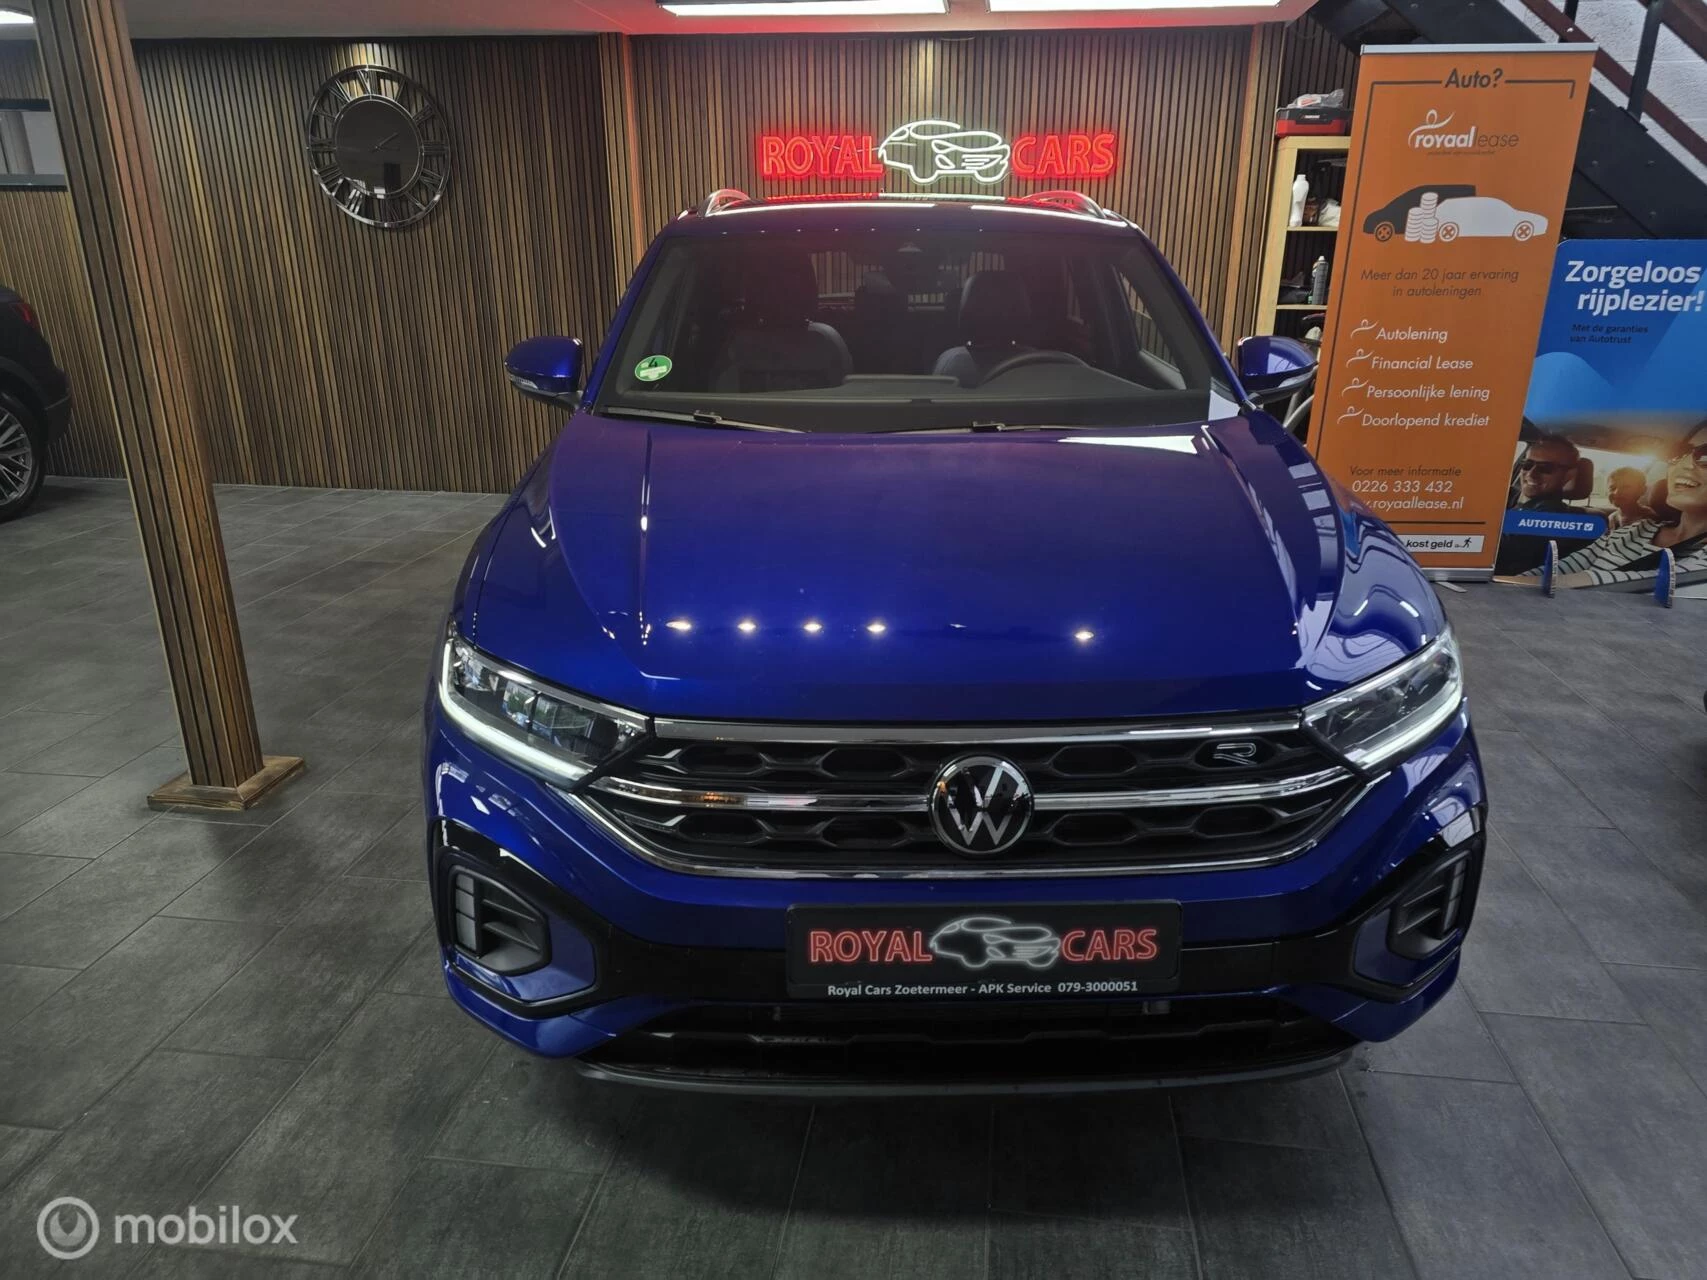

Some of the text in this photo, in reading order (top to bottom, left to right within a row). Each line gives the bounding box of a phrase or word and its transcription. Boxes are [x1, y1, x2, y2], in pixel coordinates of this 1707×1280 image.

[1444, 67, 1504, 88] Auto?
[761, 133, 1115, 175] ROYAL CARS
[1361, 268, 1519, 283] Meer dan 20 jaar ervaring
[1565, 260, 1701, 288] Zorgeloos
[1392, 284, 1482, 300] in autoleningen
[1577, 288, 1705, 316] rijplezier!
[1376, 326, 1448, 343] Autolening
[1606, 324, 1648, 334] garanties
[1588, 335, 1632, 344] Autotrust
[1372, 355, 1473, 369] Financial Lease
[1367, 384, 1490, 402] Persoonlijke lening
[1362, 413, 1490, 430] Doorlopend krediet
[1350, 465, 1462, 476] Voor meer informatie
[1352, 480, 1453, 492] 0226 333 432
[1518, 518, 1584, 531] AUTOTRUST
[1406, 540, 1454, 550] kost geld
[808, 928, 1158, 962] ROYAL CARS
[828, 984, 862, 997] Royal
[865, 984, 892, 996] Cars
[895, 984, 968, 994] Zoetermeer
[978, 983, 1004, 994] APK
[1006, 983, 1052, 993] Service
[1058, 982, 1138, 992] 079-3000051
